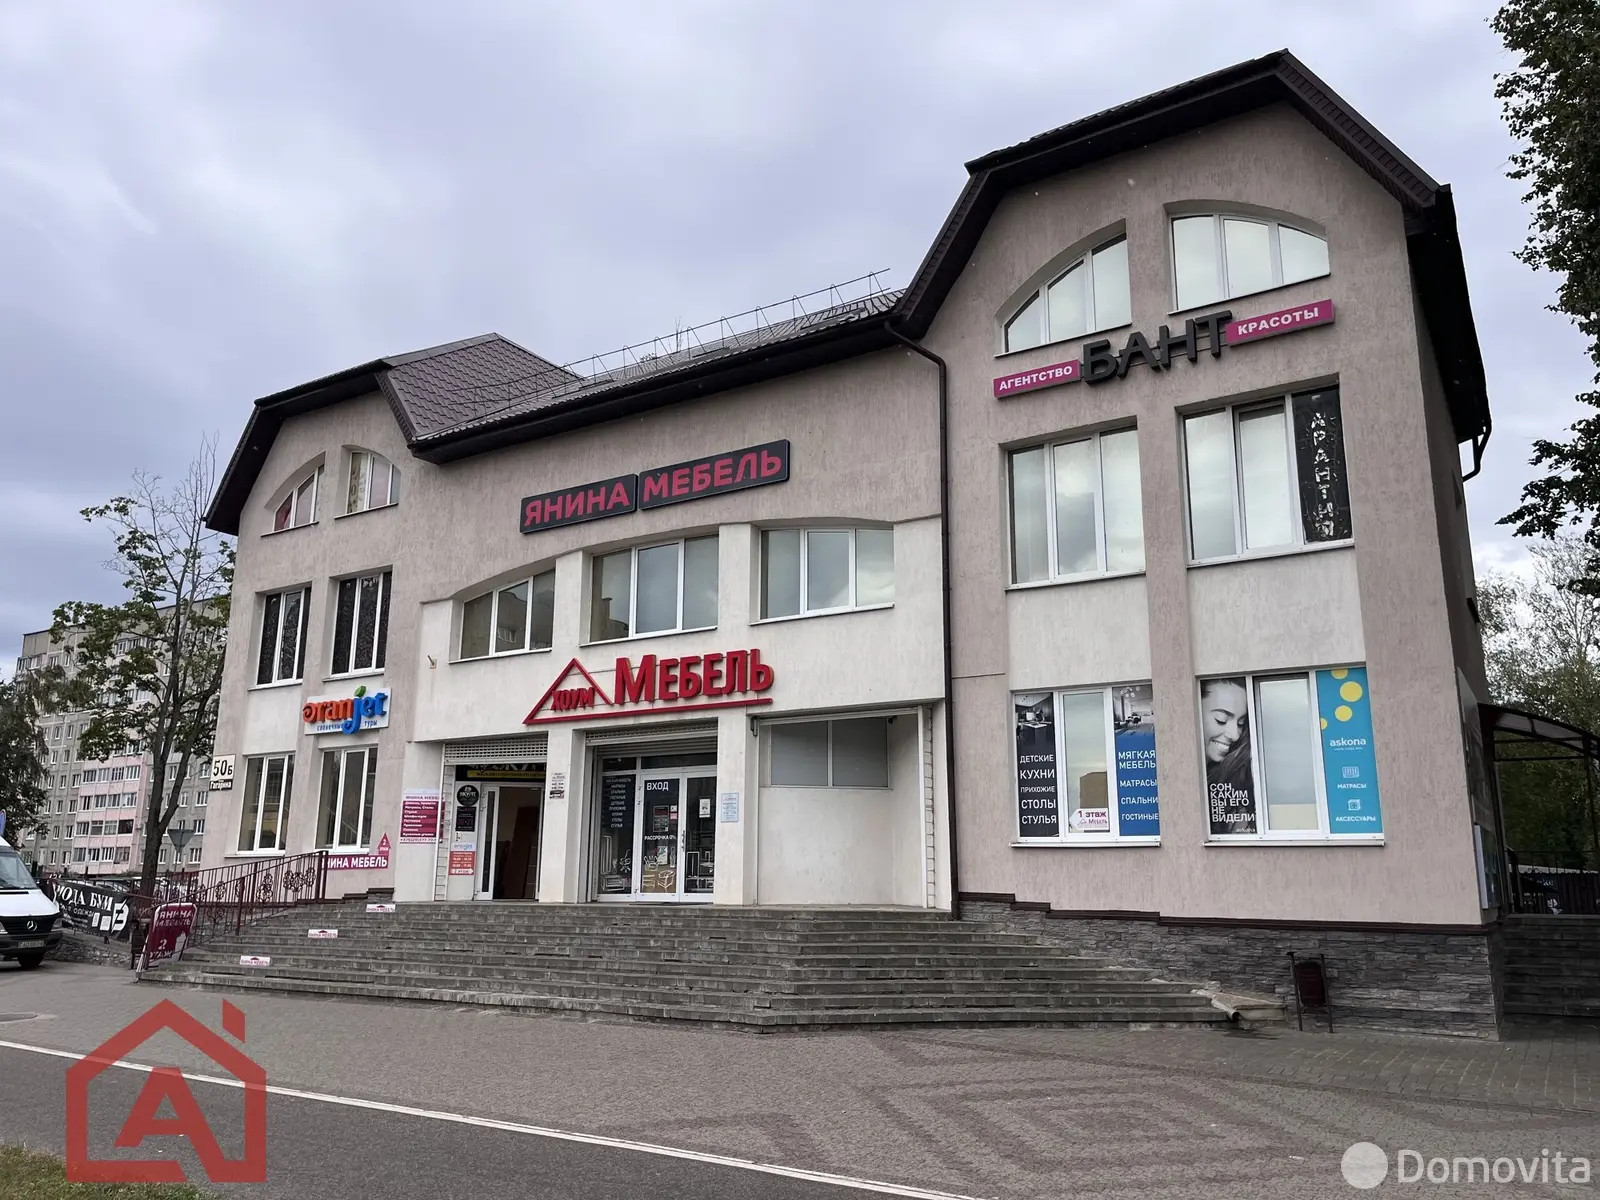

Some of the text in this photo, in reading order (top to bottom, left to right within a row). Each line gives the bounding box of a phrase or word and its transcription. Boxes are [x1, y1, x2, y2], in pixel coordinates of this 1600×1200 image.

[999, 307, 1319, 391] АГЕНТСТВО БАНТ КРАСОТЫ
[524, 450, 782, 526] ЯНИНА МЕБЕЛЬ
[550, 648, 775, 711] ХОУМ МЕБЕЛЬ
[1329, 737, 1366, 747] askona
[1020, 754, 1054, 763] ДЕТСКИЕ
[1118, 750, 1155, 760] МЯГКАЯ
[1119, 760, 1156, 770] МЕБЕЛЬ
[1020, 769, 1055, 779] КУХНИ
[647, 781, 669, 791] ВХОД
[1120, 778, 1157, 787] МАТРАСЫ
[1209, 783, 1234, 792] СОН,
[1210, 790, 1248, 799] КАКИМ
[1021, 799, 1056, 809] СТОЛЫ
[1211, 798, 1250, 807] ВЫ ЕГО
[1078, 810, 1083, 818] 1
[1211, 807, 1225, 815] НЕ
[1022, 814, 1057, 824] СТУЛЬЯ
[1212, 813, 1255, 823] ВИДЕЛИ
[351, 856, 387, 868] МЕБЕЛЬ
[90, 892, 114, 911] БУМ
[158, 939, 167, 950] 2
